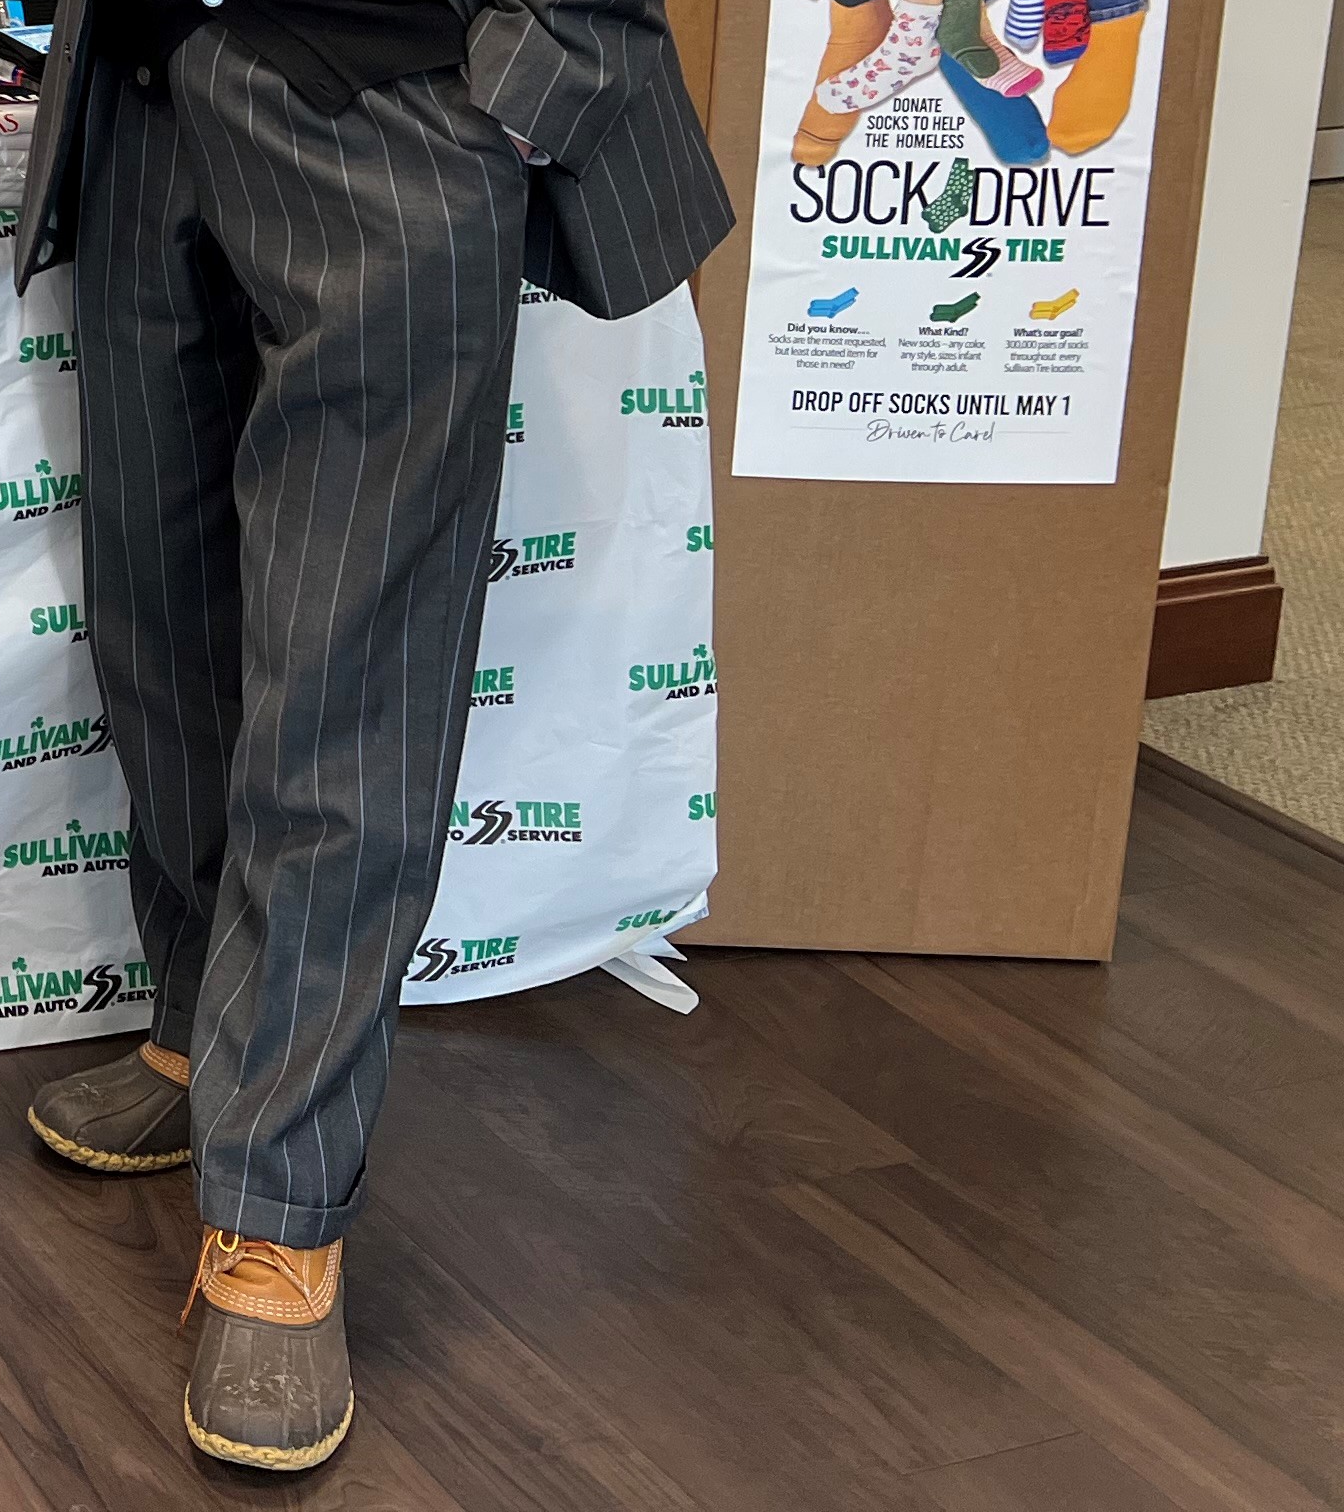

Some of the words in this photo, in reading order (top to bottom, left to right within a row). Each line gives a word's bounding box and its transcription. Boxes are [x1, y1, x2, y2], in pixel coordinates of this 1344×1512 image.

[893, 98, 943, 114] DONATE
[867, 115, 909, 132] SOCKS
[913, 116, 930, 132] TO
[933, 117, 965, 134] HELP
[865, 133, 890, 148] THE
[896, 133, 964, 150] HOMELESS
[789, 159, 942, 227] SOCK
[970, 167, 1114, 228] DRIVE
[821, 235, 961, 262] SULLIVAN
[1006, 239, 1066, 263] TIRE
[919, 327, 942, 336] What
[944, 327, 969, 336] Kind?
[1043, 330, 1059, 338] our
[792, 390, 845, 414] DROP
[848, 392, 885, 414] OFF
[889, 393, 951, 416] SOCKS
[955, 394, 1011, 417] UNTIL
[1016, 395, 1057, 417] MAY
[1062, 396, 1070, 416] 1
[866, 418, 930, 442] Driven
[930, 420, 946, 442] to
[516, 800, 581, 830] TIRE
[507, 829, 583, 843] SERVICE
